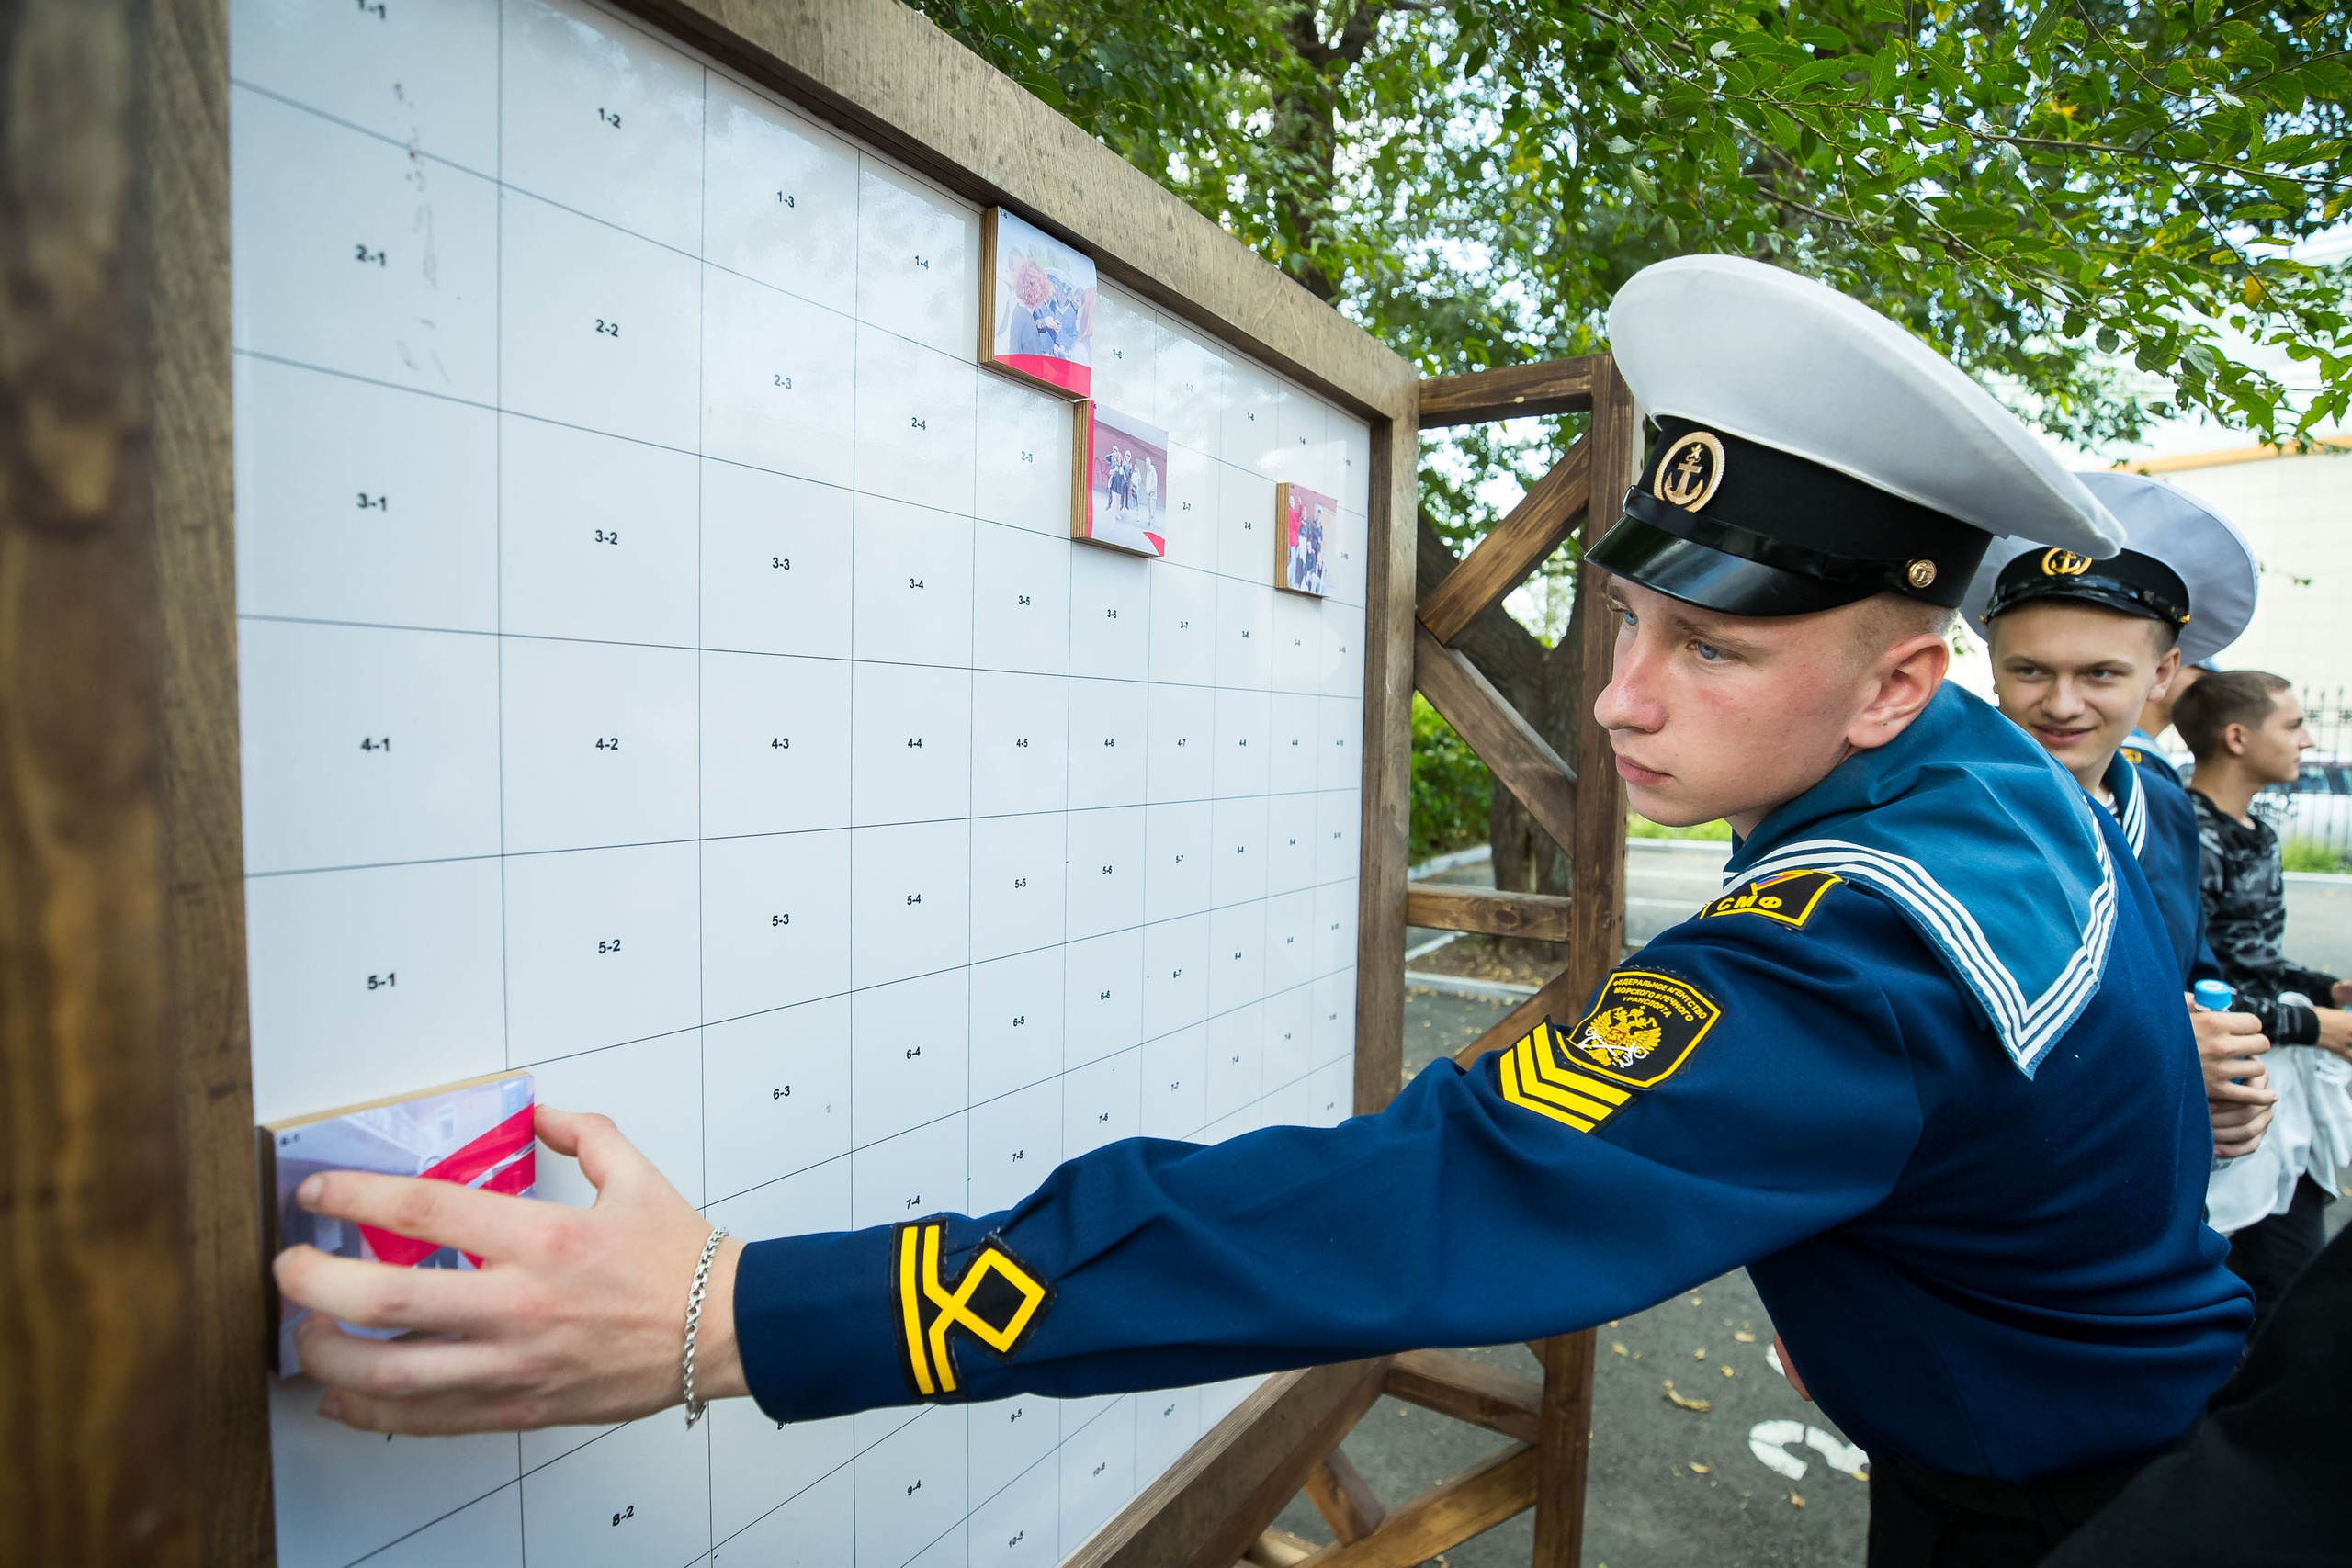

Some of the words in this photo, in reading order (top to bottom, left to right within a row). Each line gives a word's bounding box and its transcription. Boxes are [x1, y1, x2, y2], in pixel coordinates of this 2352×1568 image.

[597, 107, 621, 130] 1-2
[776, 190, 795, 209] 1-3
[355, 243, 387, 267] 2-1
[914, 254, 930, 271] 1-4
[594, 318, 619, 338] 2-2
[1112, 348, 1123, 360] 1-6
[774, 374, 792, 390] 2-3
[910, 416, 927, 431] 2-4
[1021, 450, 1034, 464] 2-5
[356, 491, 388, 512] 3-1
[1182, 502, 1192, 512] 2-7
[594, 528, 618, 546] 3-2
[772, 556, 791, 571] 3-3
[909, 577, 924, 591] 3-4
[1018, 594, 1031, 606] 3-5
[1106, 608, 1117, 619] 3-6
[1180, 620, 1189, 630] 3-7
[359, 737, 390, 753] 4-1
[594, 737, 619, 751] 4-2
[771, 737, 790, 750] 4-3
[907, 737, 922, 750] 4-4
[1015, 738, 1029, 749] 4-5
[1103, 738, 1115, 748] 4-6
[1177, 738, 1186, 747] 4-7
[1175, 854, 1184, 864] 5-7
[1102, 864, 1113, 875] 5-6
[1014, 877, 1027, 889] 5-5
[906, 893, 922, 907] 5-4
[1716, 895, 1782, 911] СМФ
[771, 913, 790, 928] 5-3
[597, 938, 621, 954] 5-2
[1172, 968, 1182, 979] 6-7
[367, 972, 396, 991] 5-1
[1100, 989, 1111, 1001] 6-6
[1612, 978, 1668, 992] ФЕДЕРАЛЬНОЕ
[1667, 987, 1707, 1020] АГЕНТСТВО
[1613, 987, 1656, 998] МОРСКОГО
[1660, 994, 1694, 1021] РЕЧНОГО
[1623, 997, 1672, 1018] ТРАНСПОРТА
[1012, 1015, 1025, 1028] 6-5
[906, 1045, 922, 1060] 6-4
[773, 1085, 791, 1100] 6-3
[1098, 1112, 1109, 1124] 7-6
[1012, 1149, 1024, 1163] 7-5
[905, 1194, 922, 1210] 7-4
[1010, 1407, 1023, 1424] 9-5
[907, 1479, 922, 1497] 9-4
[612, 1505, 635, 1528] 8-2
[1008, 1529, 1024, 1549] 10-5
